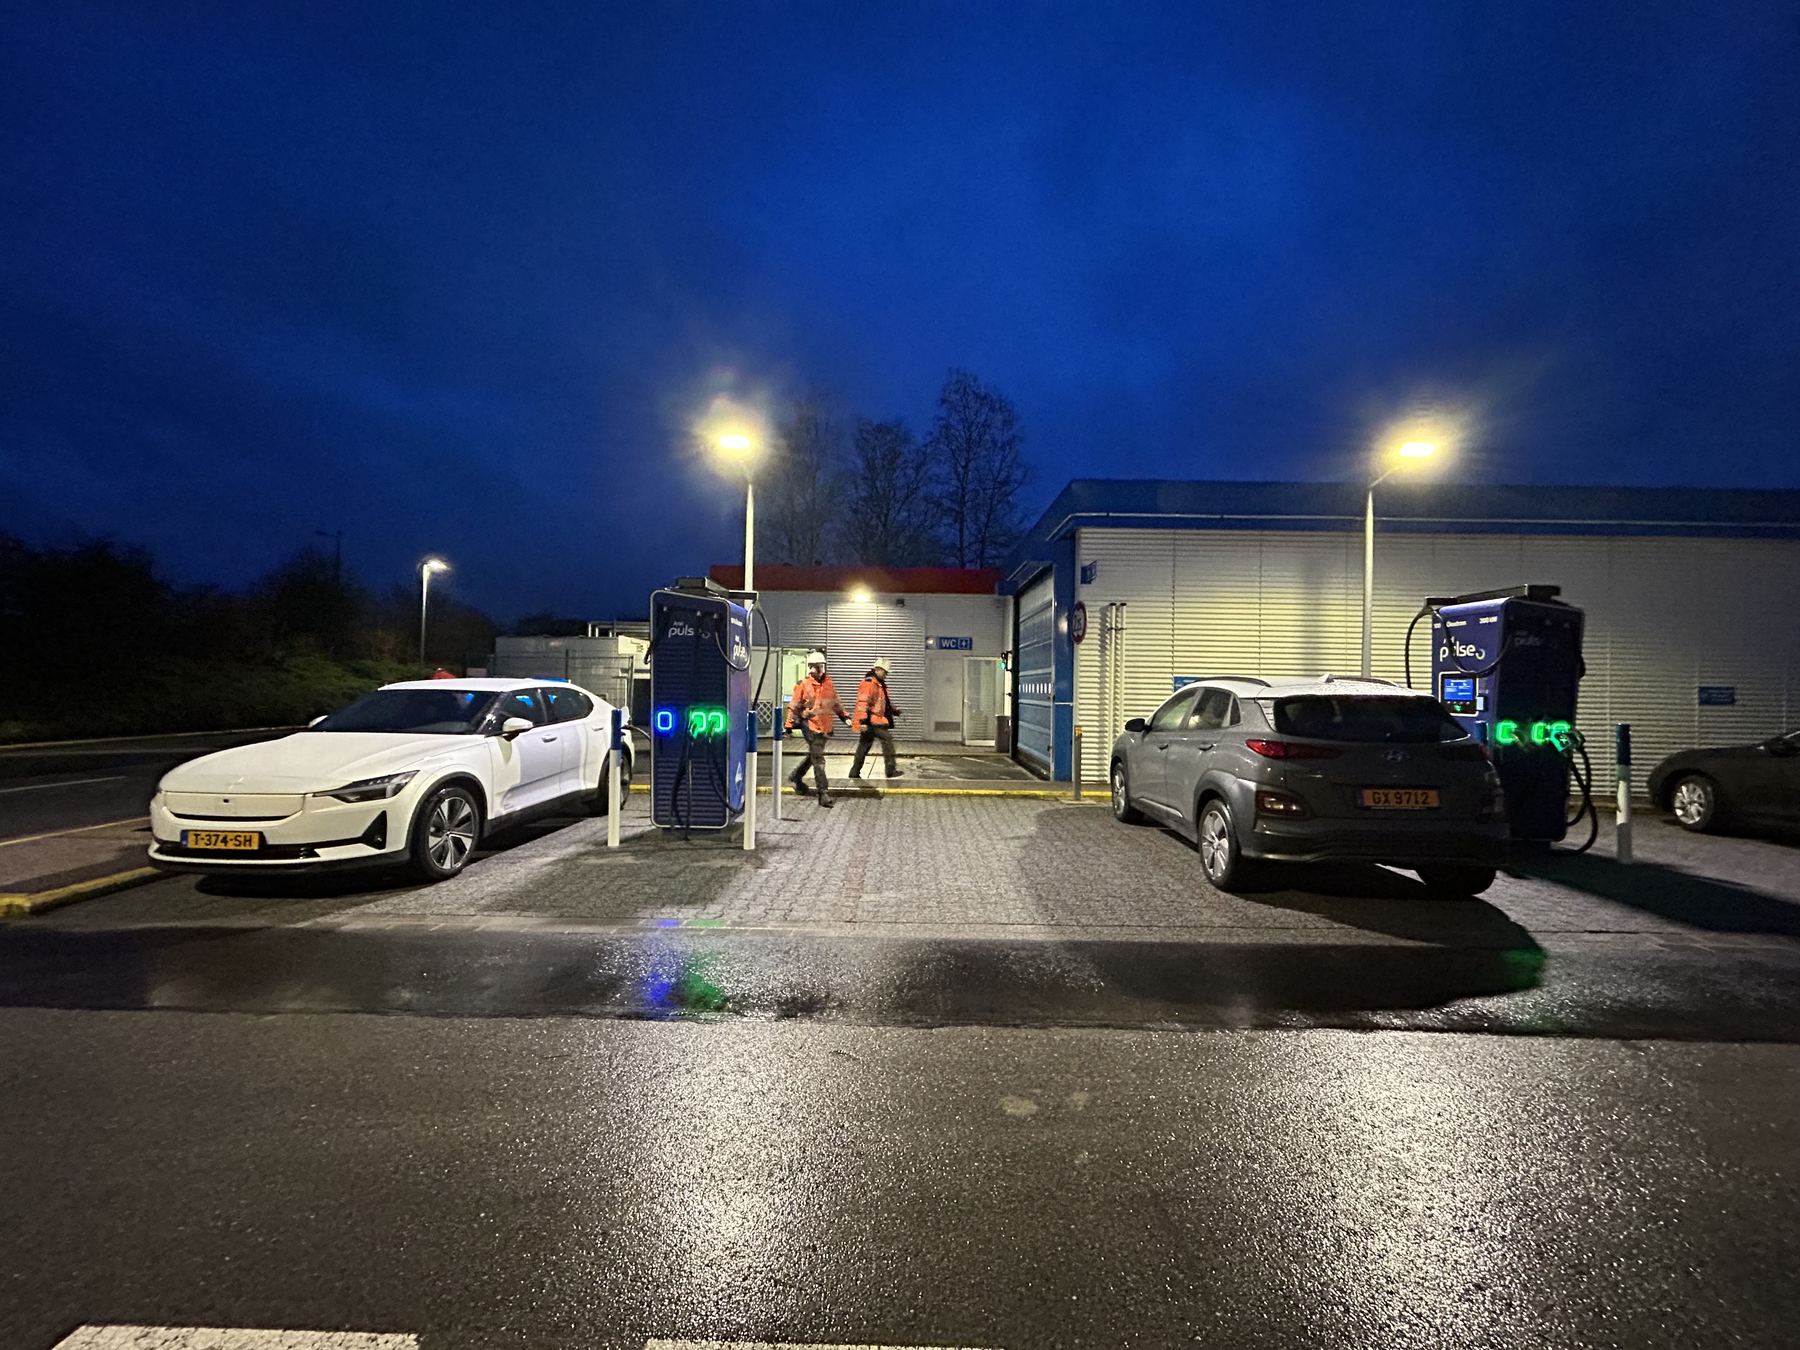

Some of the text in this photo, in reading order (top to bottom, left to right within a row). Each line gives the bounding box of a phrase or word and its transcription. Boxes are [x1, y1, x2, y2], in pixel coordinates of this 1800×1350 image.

[941, 639, 957, 647] WC
[1372, 791, 1430, 805] GX 9712
[192, 833, 253, 848] T-374-SH
